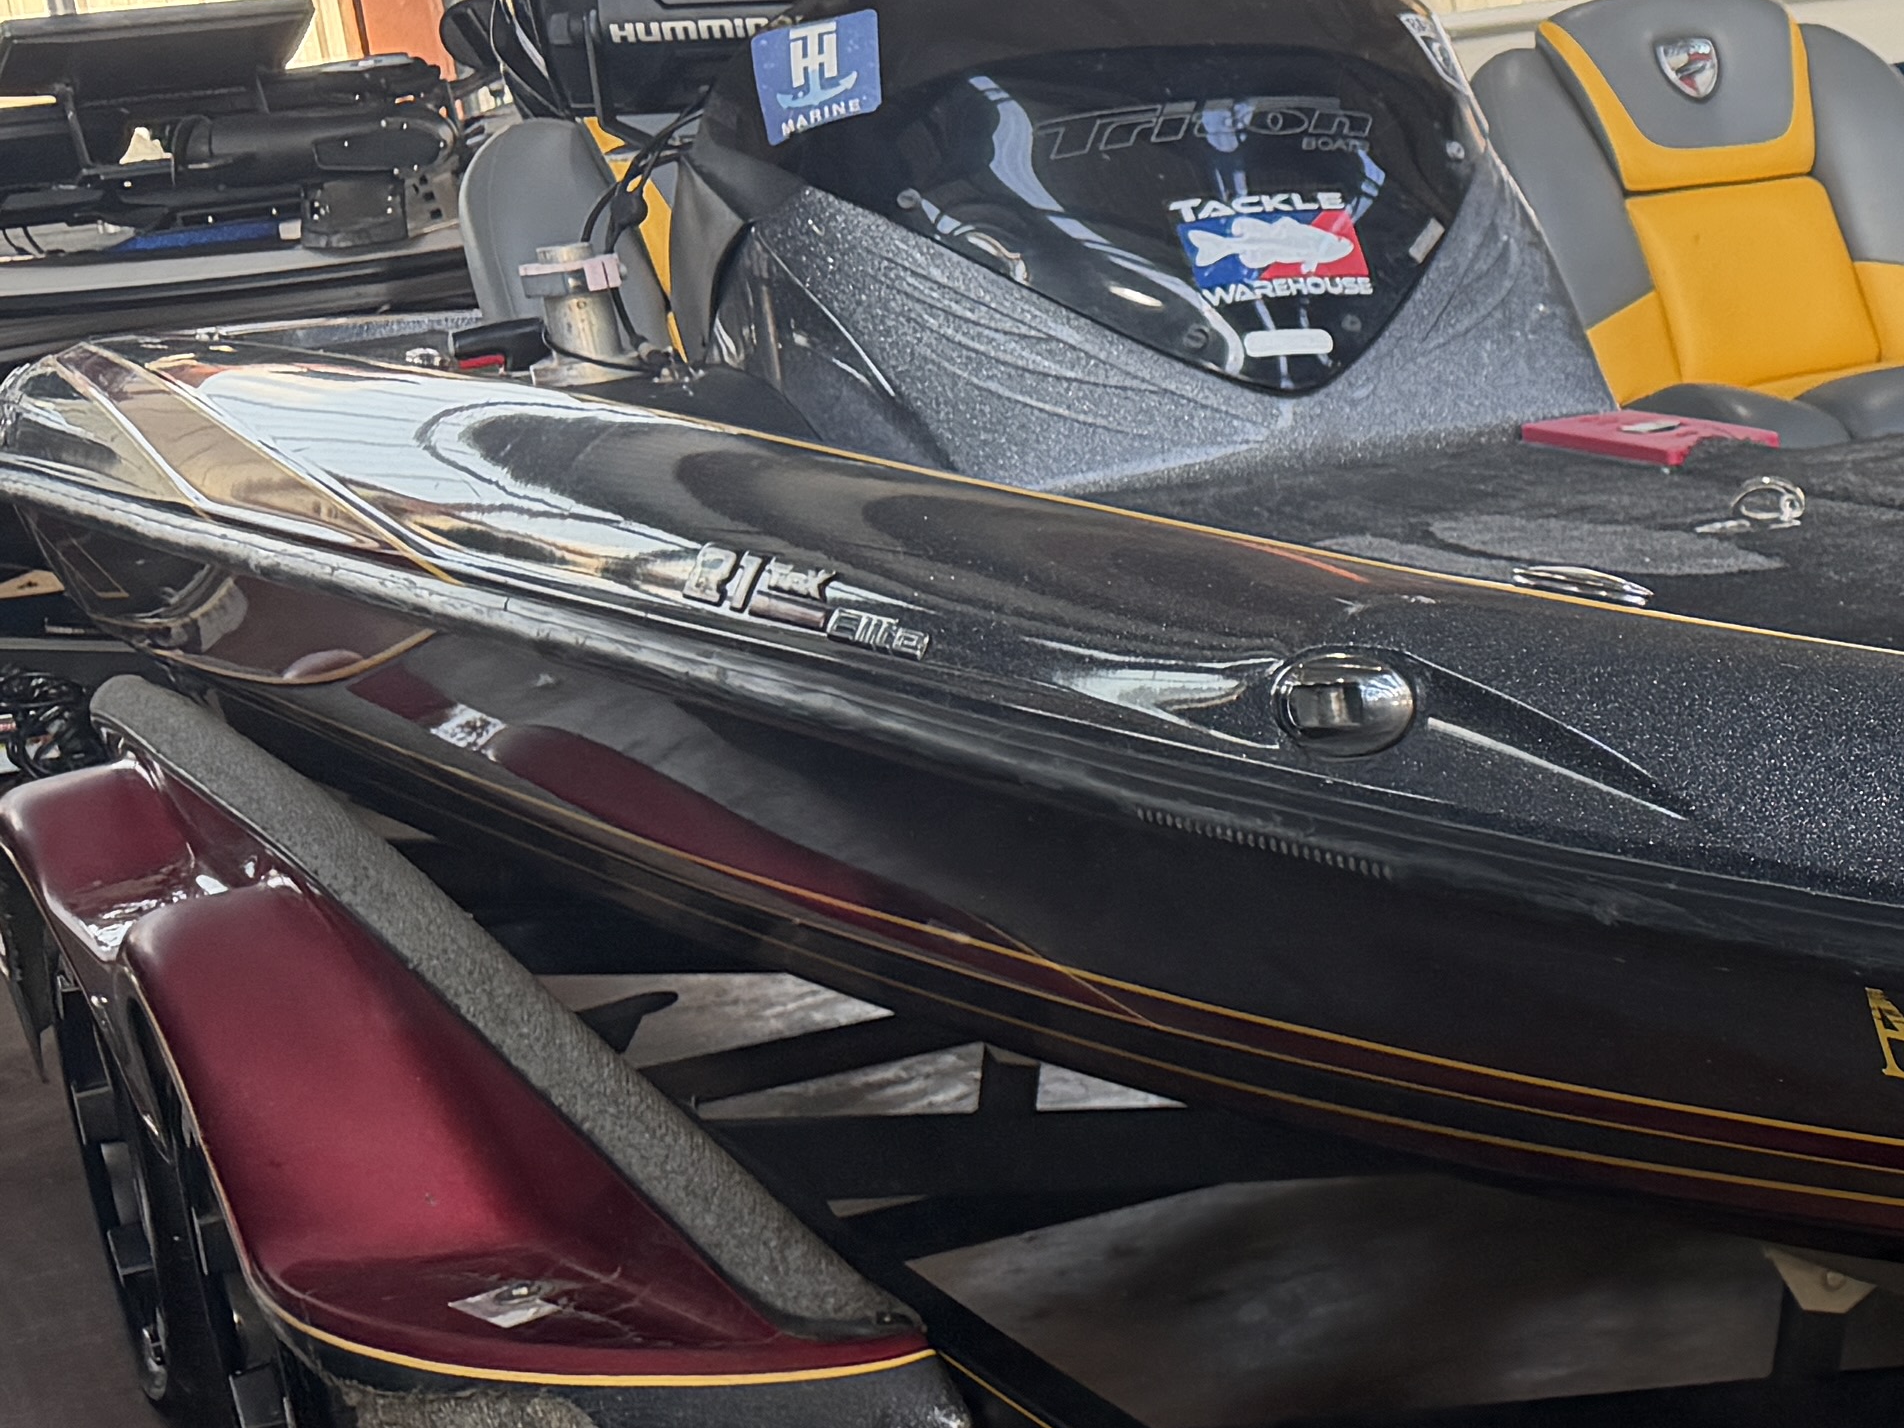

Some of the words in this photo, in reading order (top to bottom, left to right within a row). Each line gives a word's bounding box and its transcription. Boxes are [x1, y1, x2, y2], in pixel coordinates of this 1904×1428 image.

[781, 98, 862, 138] MARINE
[1168, 191, 1346, 223] TACKLE
[1201, 276, 1374, 308] WAREHOUSE
